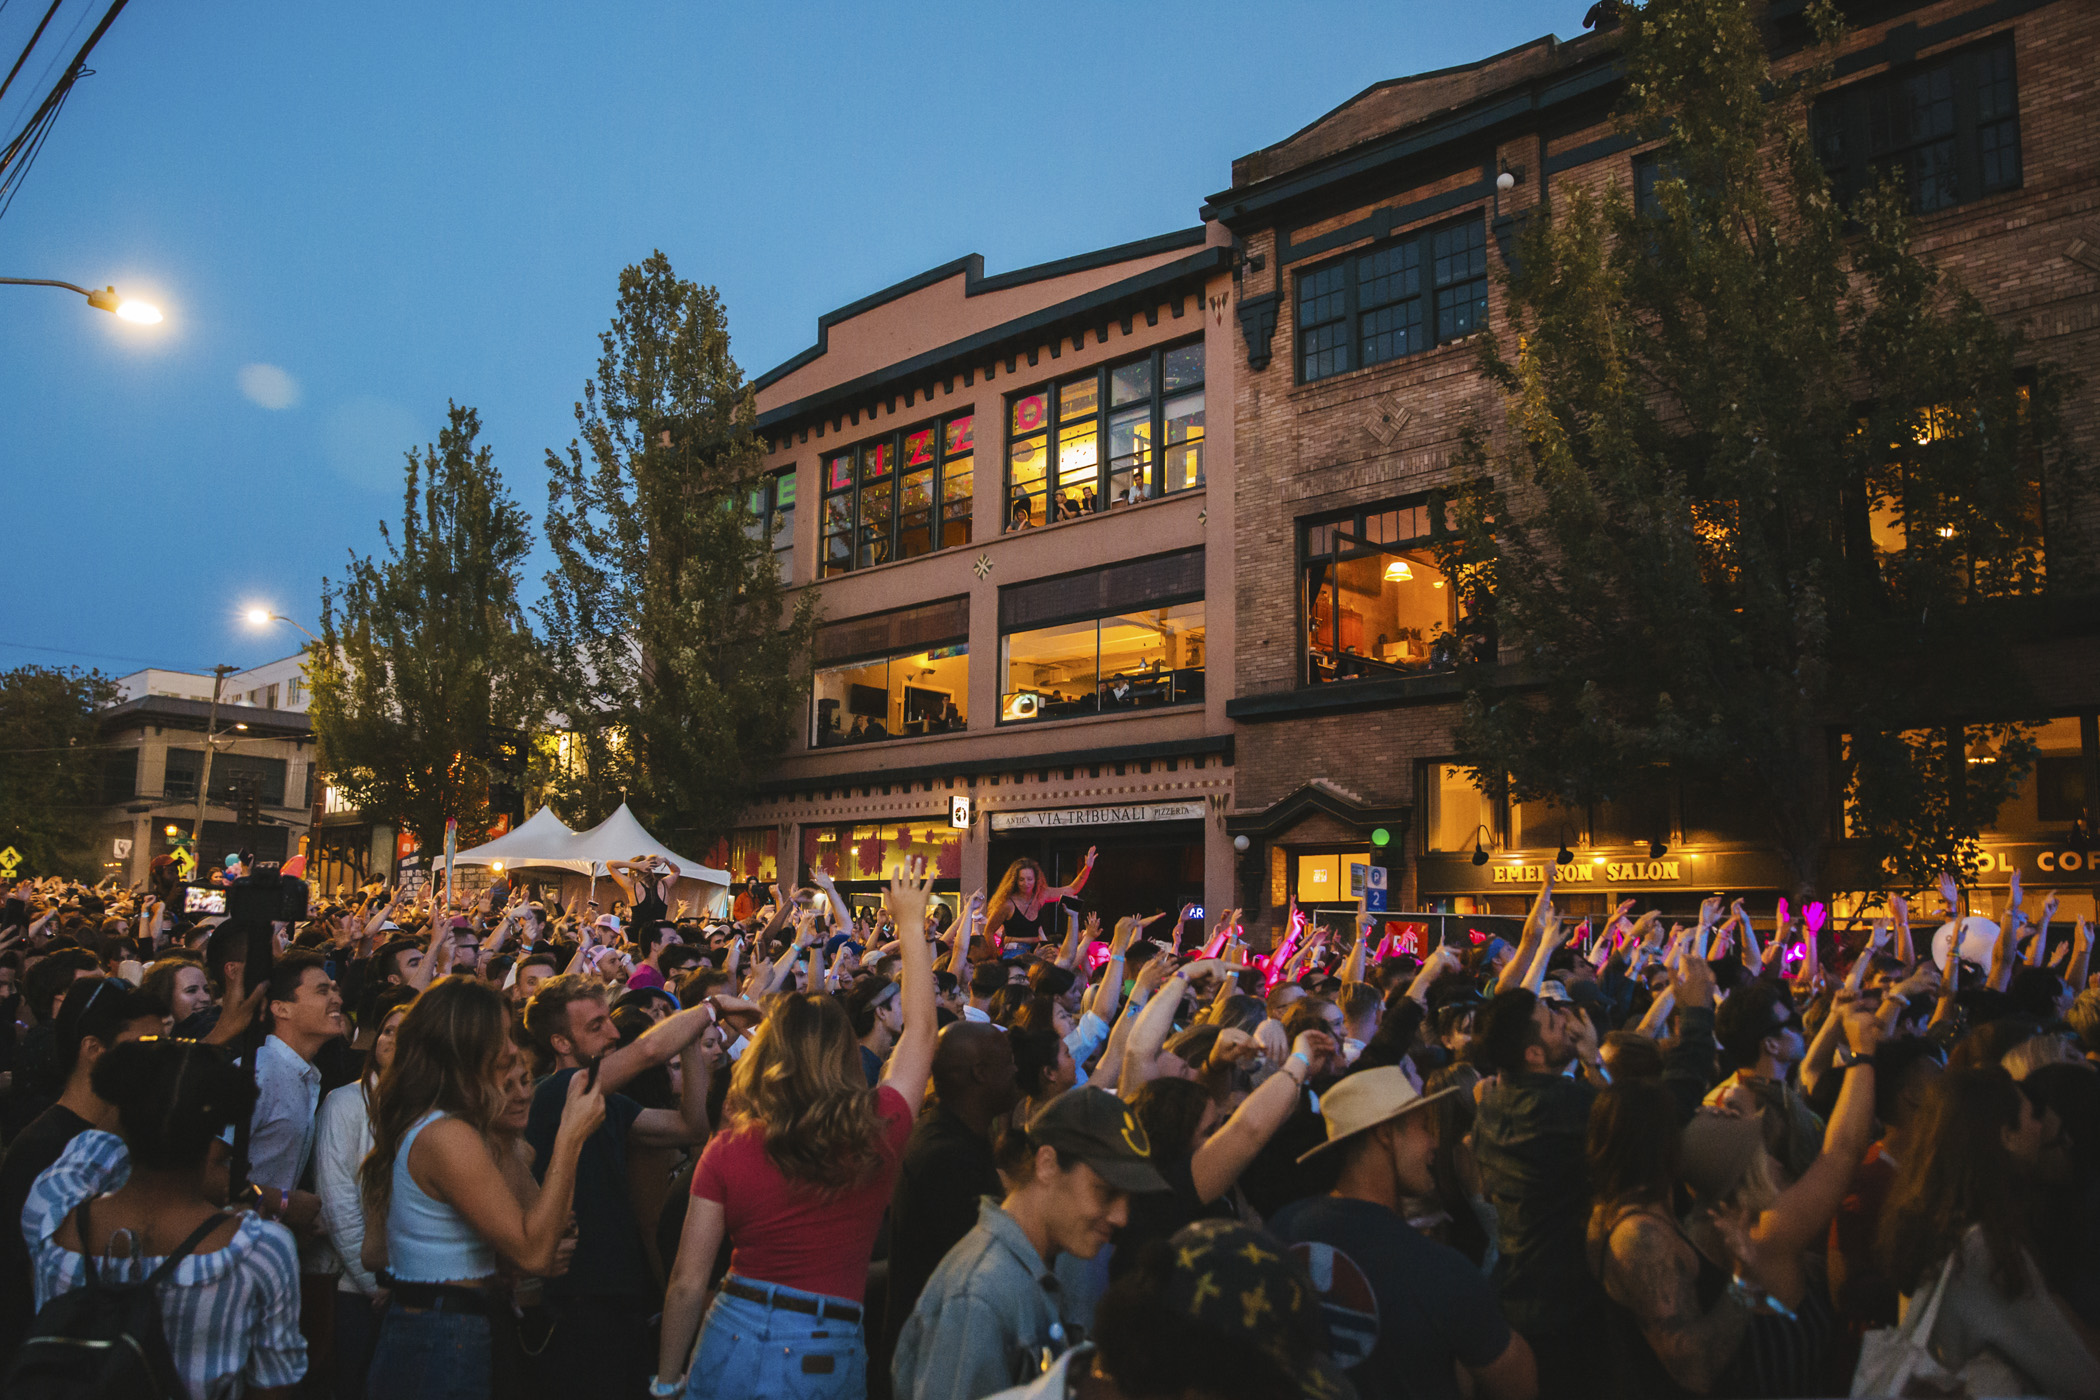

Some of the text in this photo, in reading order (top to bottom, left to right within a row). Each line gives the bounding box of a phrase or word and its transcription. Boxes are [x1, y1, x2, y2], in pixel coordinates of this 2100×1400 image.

[831, 395, 1043, 490] LIZZO
[1037, 811, 1061, 825] VIA
[1067, 807, 1146, 825] TRIBUNALI
[1154, 806, 1190, 816] PIZZERIA
[1607, 861, 1680, 882] SALON
[1373, 891, 1380, 906] 2
